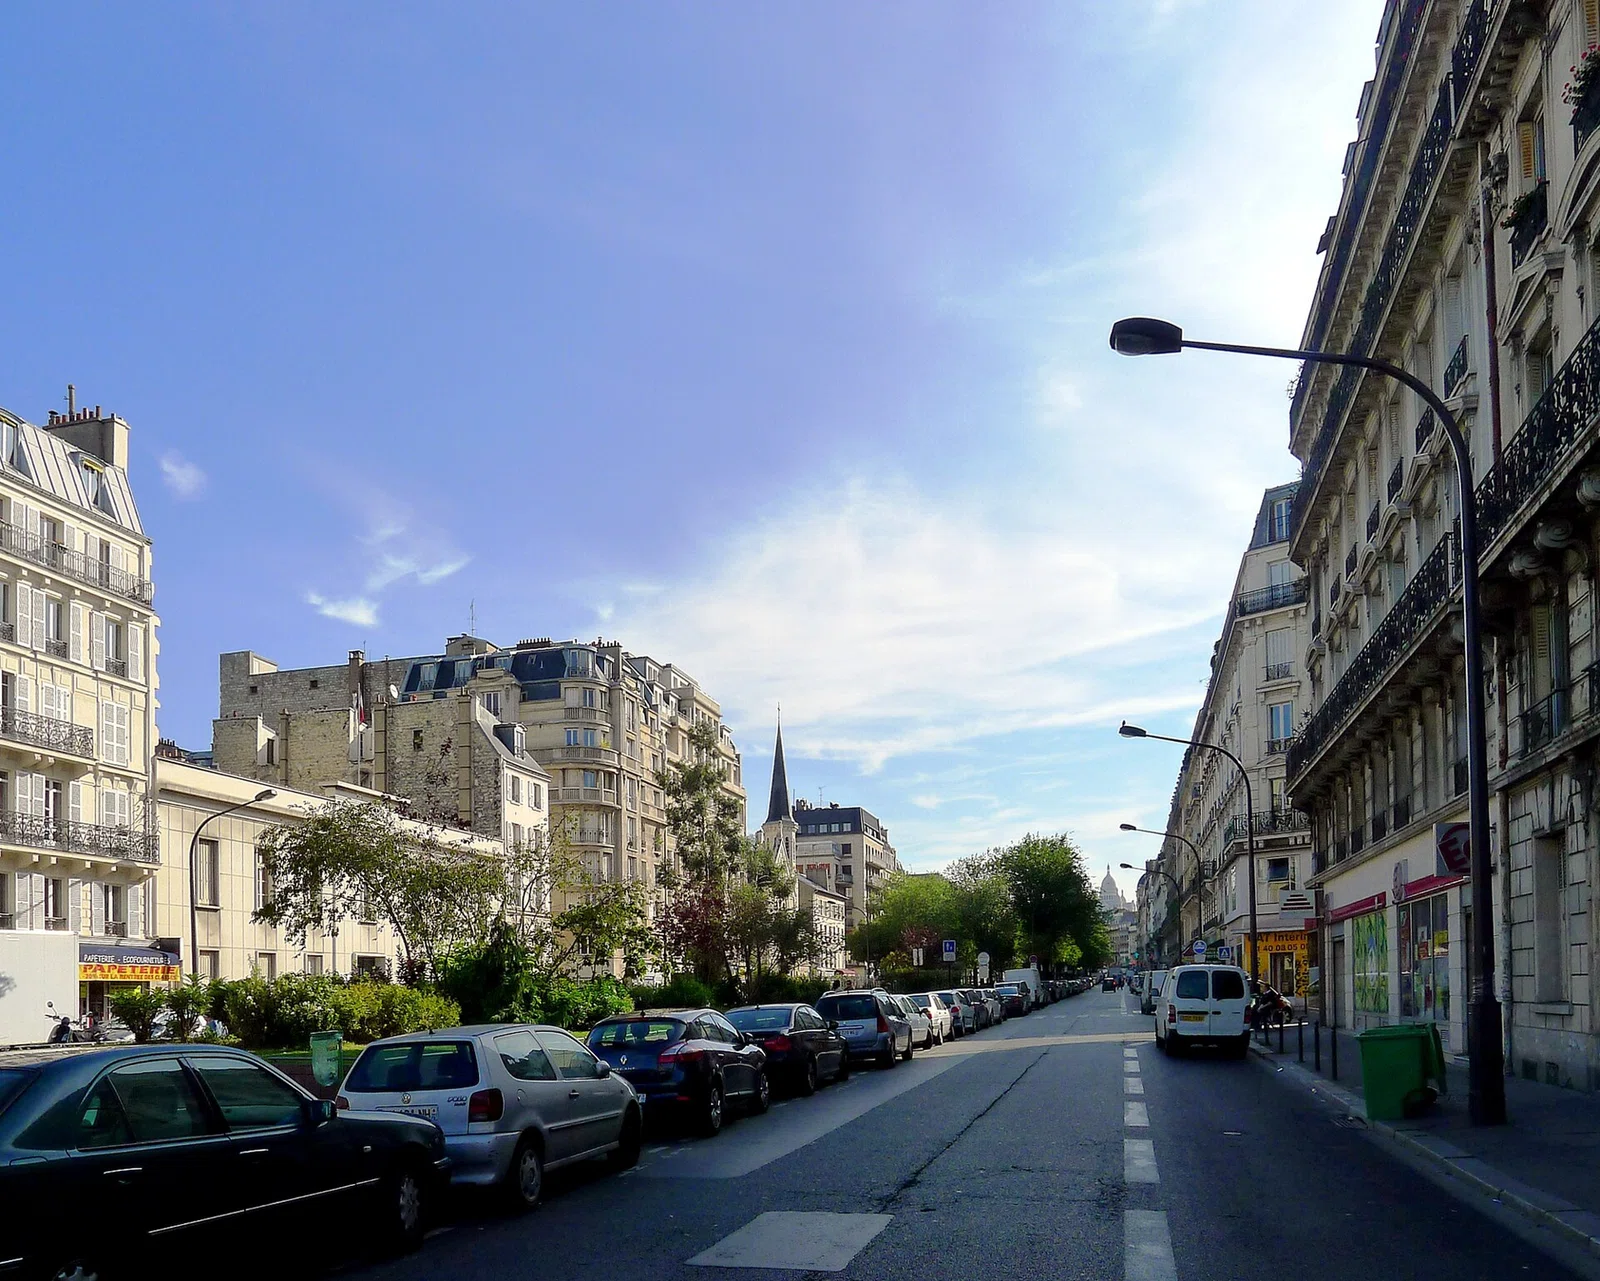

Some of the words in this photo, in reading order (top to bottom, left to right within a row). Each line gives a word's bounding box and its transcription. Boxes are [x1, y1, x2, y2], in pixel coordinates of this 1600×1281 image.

[1287, 943, 1298, 951] 05
[84, 954, 115, 963] PAPETERIE
[83, 964, 176, 974] PAPETERIE
